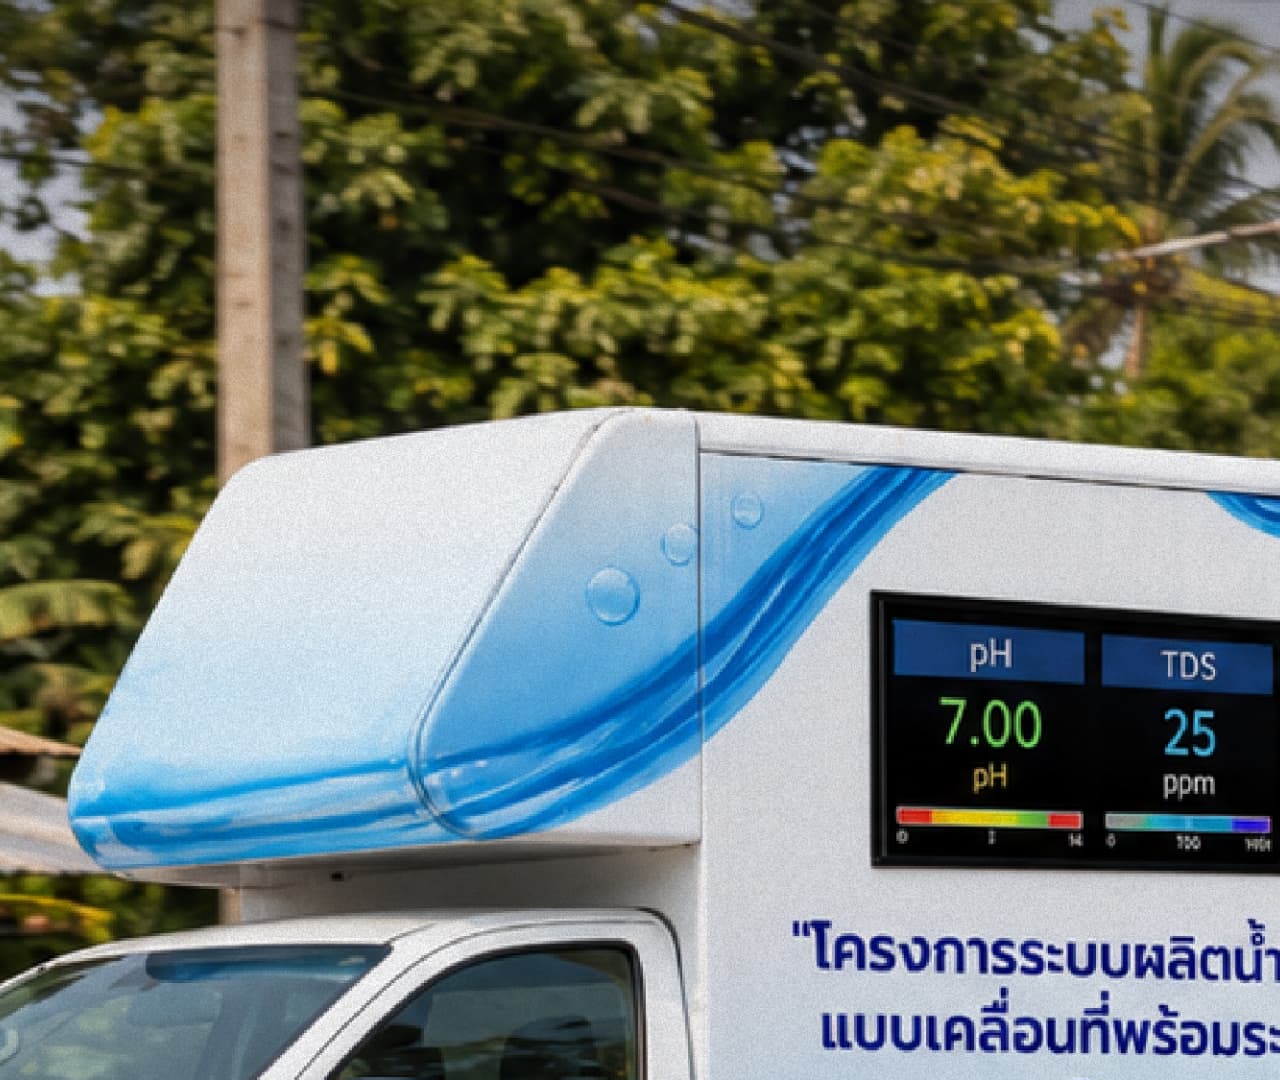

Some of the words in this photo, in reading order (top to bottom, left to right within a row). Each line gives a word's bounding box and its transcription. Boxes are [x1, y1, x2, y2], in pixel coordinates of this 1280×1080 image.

[970, 637, 1014, 673] pH
[1160, 650, 1217, 681] TDS
[938, 696, 1043, 750] 7.00
[1163, 708, 1216, 758] 25
[972, 761, 1008, 795] pH
[1162, 772, 1216, 801] ppm
